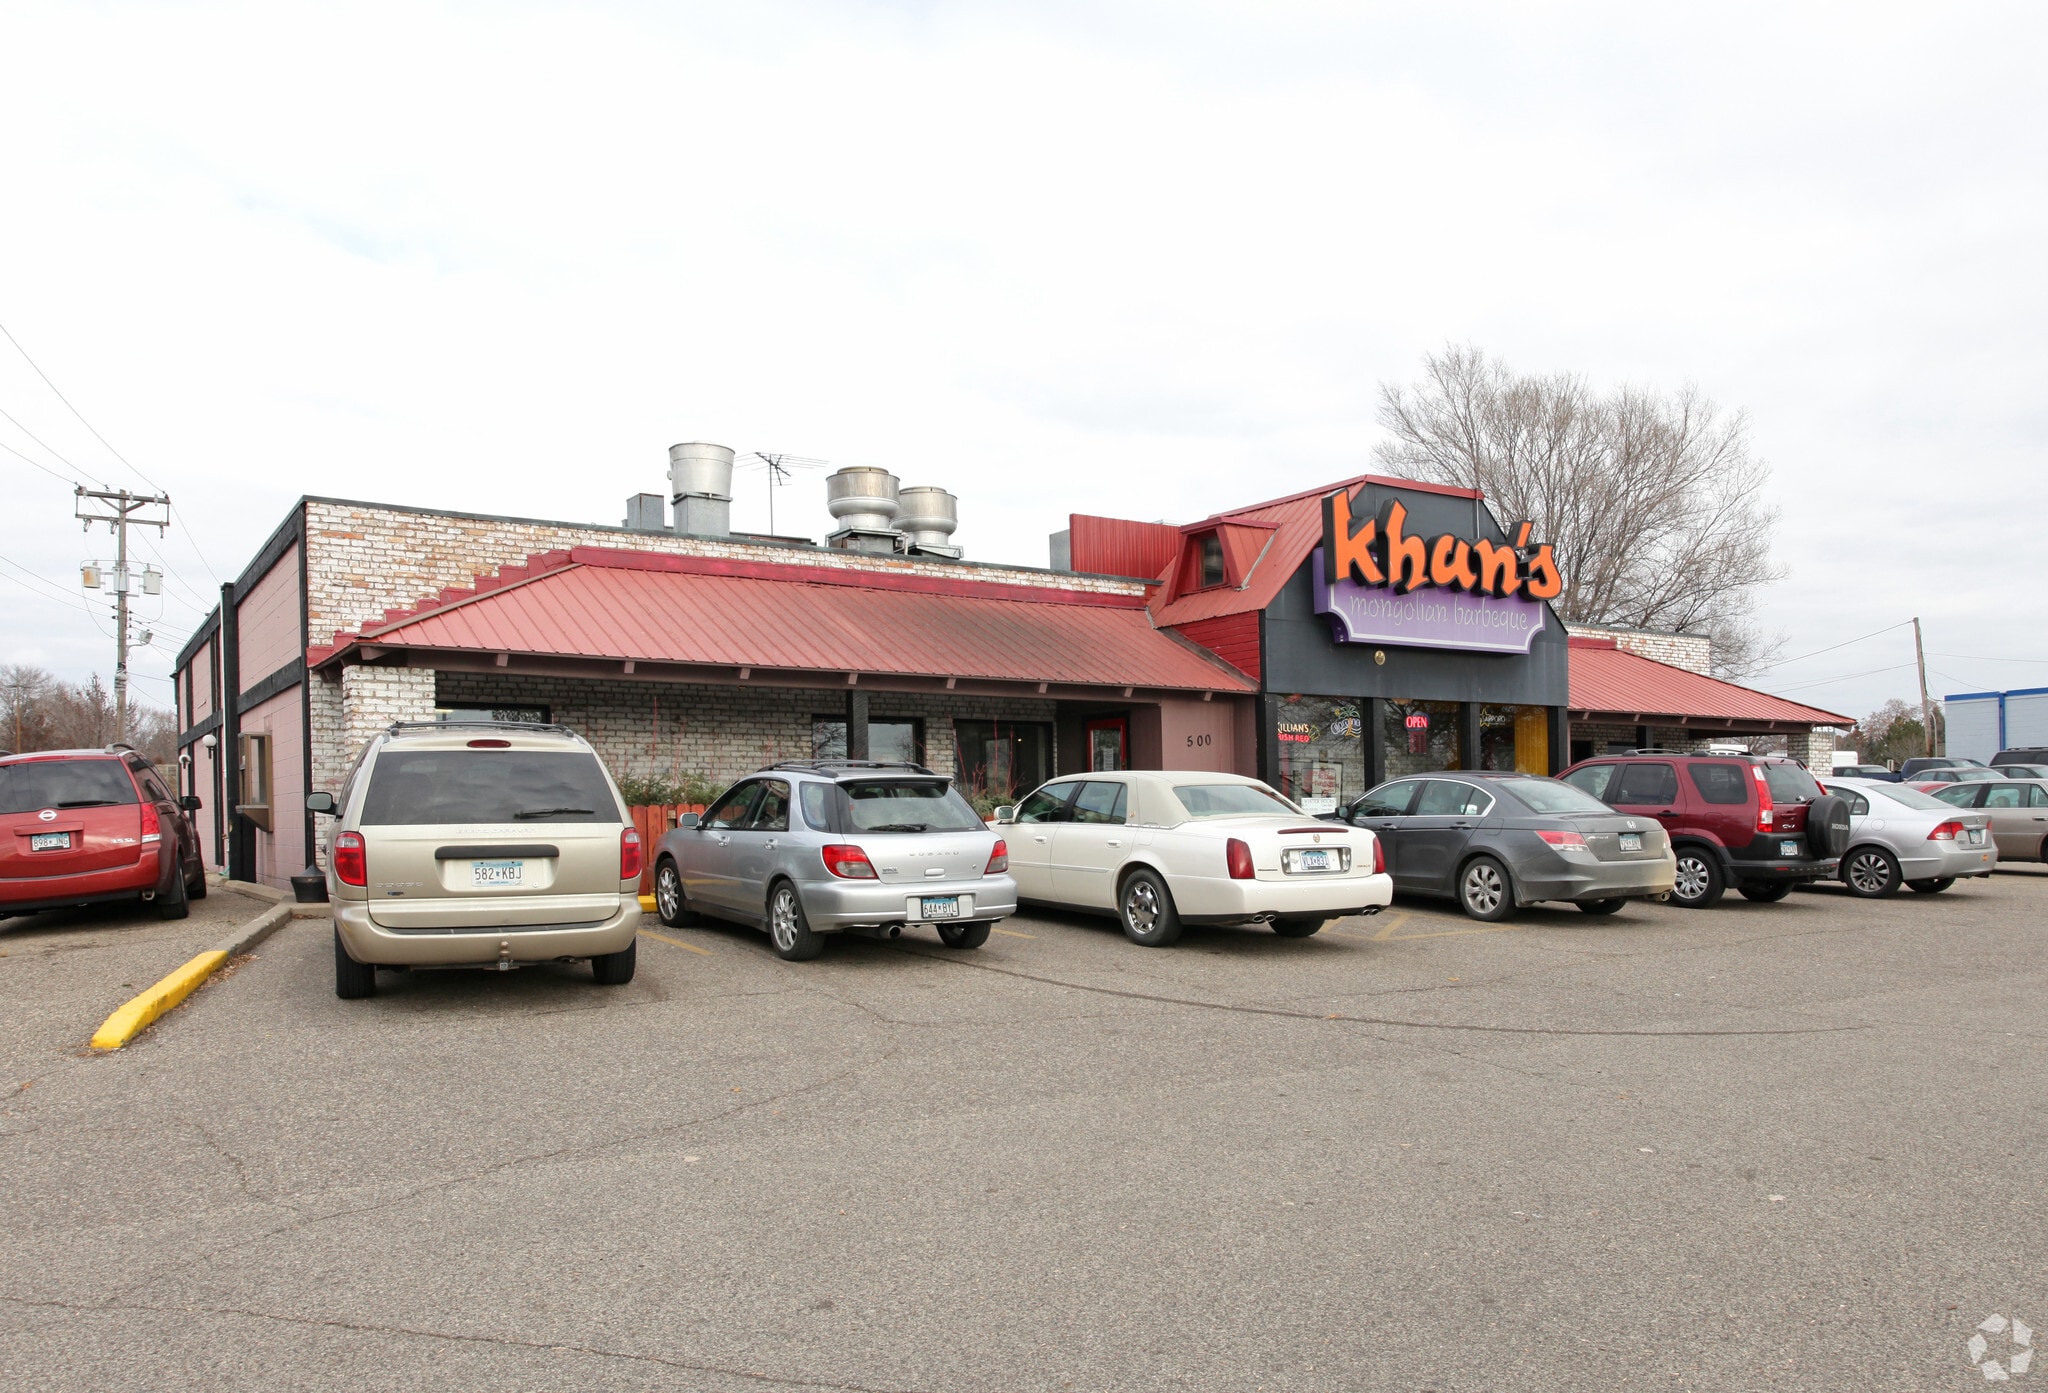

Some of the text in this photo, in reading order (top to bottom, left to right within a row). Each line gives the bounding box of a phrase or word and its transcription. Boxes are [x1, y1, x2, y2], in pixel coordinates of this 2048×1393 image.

[1328, 489, 1563, 599] khan's
[1349, 592, 1528, 633] mongolian barbeque
[1405, 716, 1427, 728] OPEN
[1187, 734, 1211, 747] 500
[1278, 733, 1310, 742] RISH RED
[474, 866, 522, 880] 582 KBJ
